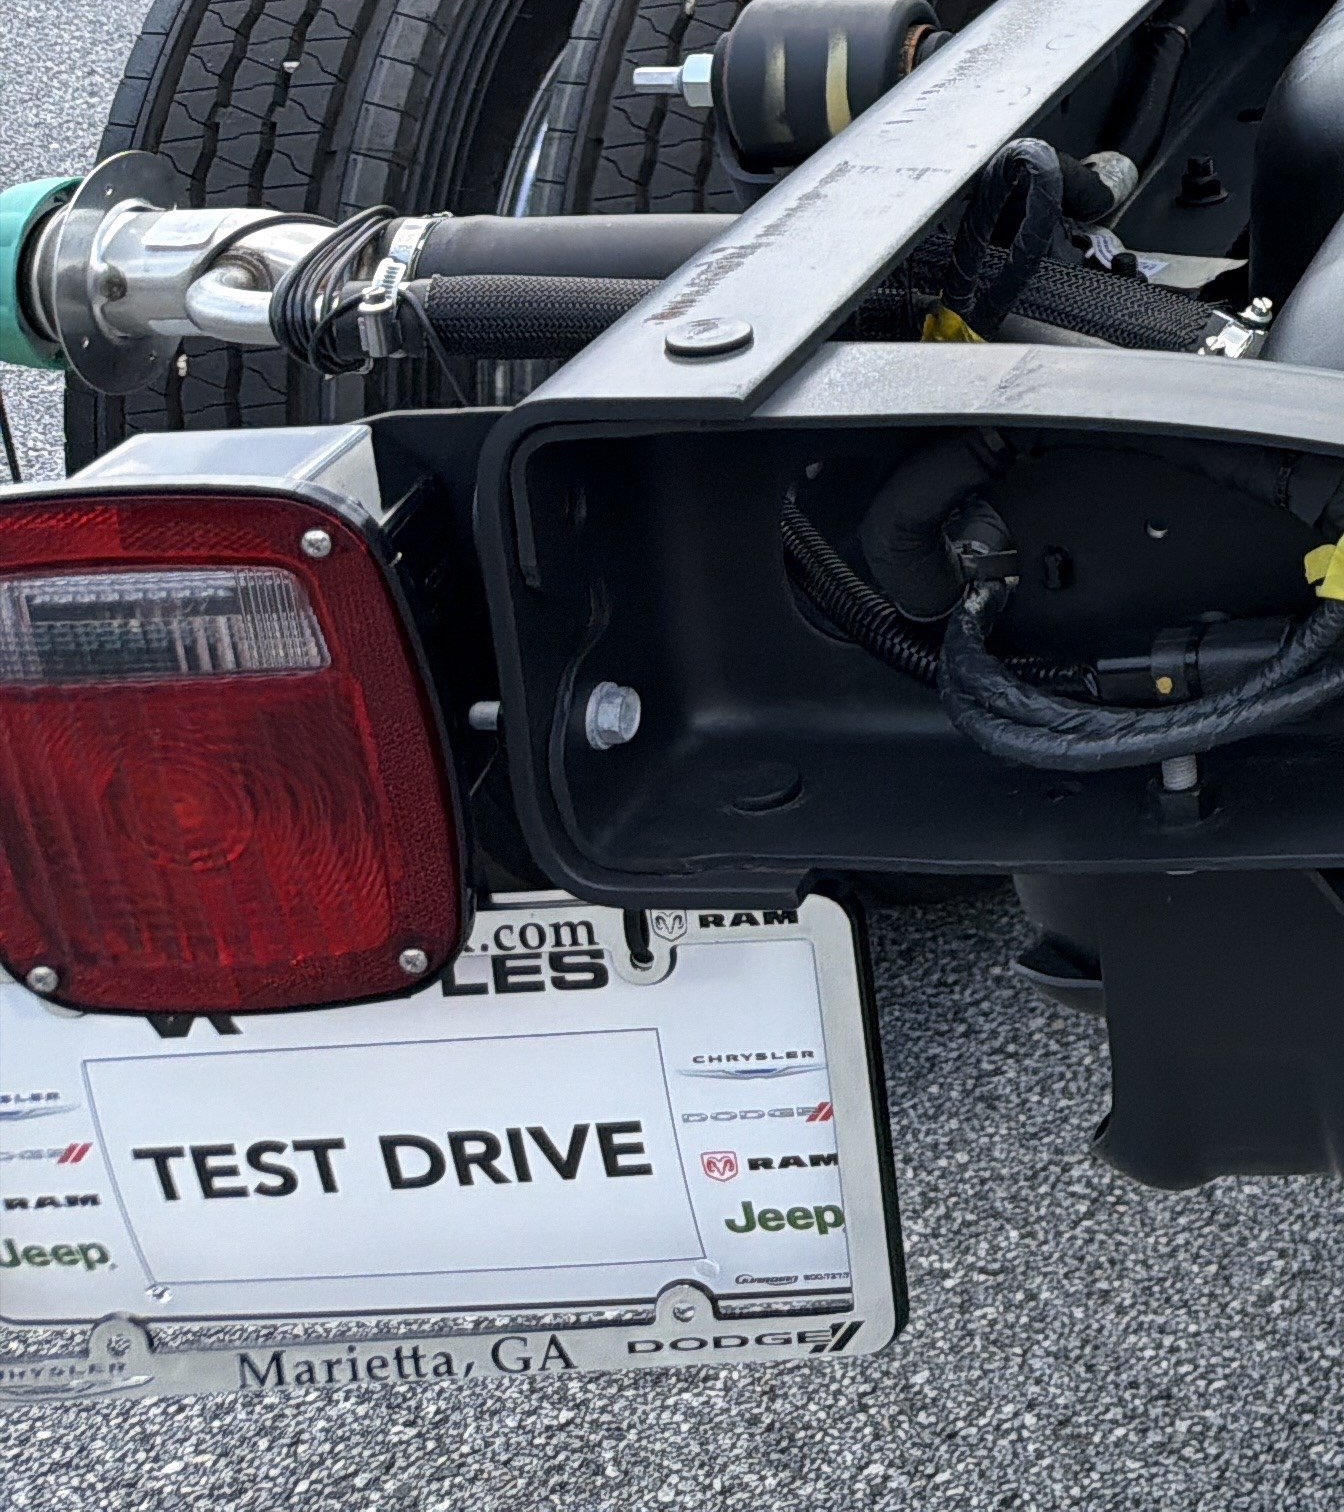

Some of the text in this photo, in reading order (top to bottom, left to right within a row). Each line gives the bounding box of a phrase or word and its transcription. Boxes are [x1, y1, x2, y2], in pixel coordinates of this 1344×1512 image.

[699, 908, 799, 929] RAM
[464, 917, 600, 953] .com
[692, 1050, 815, 1064] CHRYSLER
[681, 1106, 818, 1123] DODGE
[131, 1119, 654, 1202] TEST DRIVE
[747, 1152, 839, 1171] RAM
[3, 1193, 100, 1210] RAM
[724, 1200, 844, 1235] Jeep
[0, 1238, 110, 1271] Jeep
[627, 1330, 832, 1355] DODGE
[237, 1333, 580, 1388] Marietta, GA
